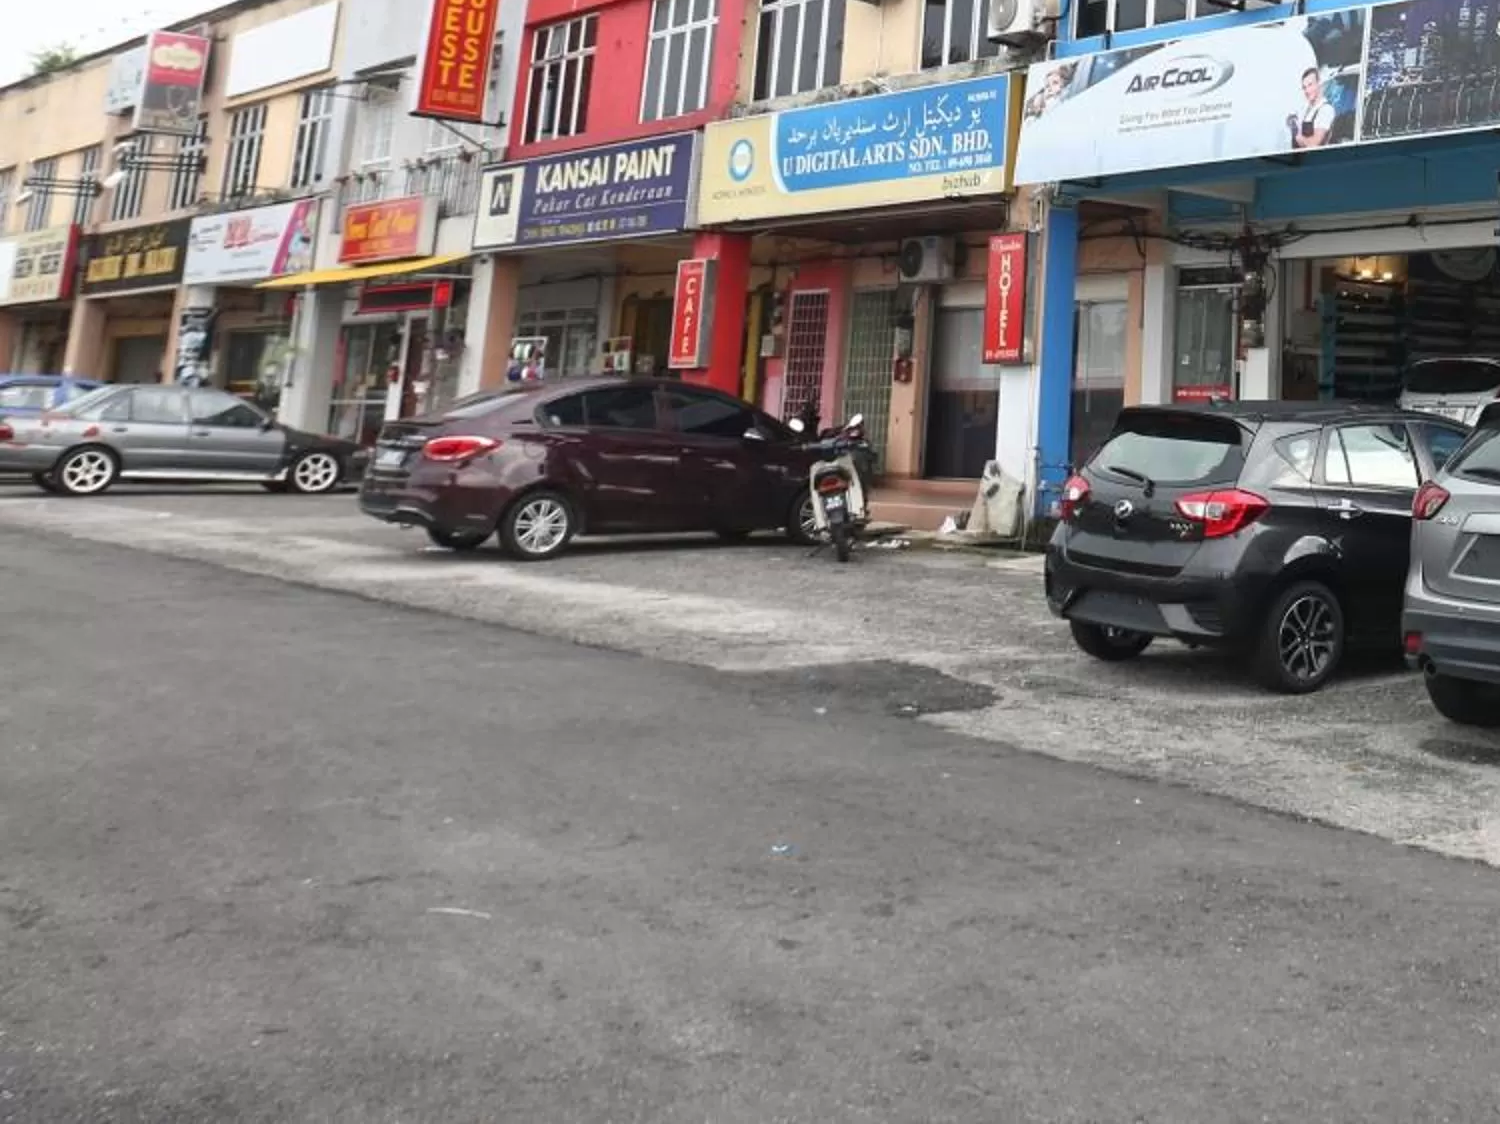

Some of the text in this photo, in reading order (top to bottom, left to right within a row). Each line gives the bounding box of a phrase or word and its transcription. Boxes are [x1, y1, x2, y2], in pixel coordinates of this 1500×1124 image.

[535, 144, 677, 195] KANSAI PAINT
[783, 129, 993, 177] U DIGITAL ARTS SDN. BHD.
[532, 196, 571, 215] Pakar
[600, 185, 673, 207] Kenderaan
[681, 277, 698, 354] CAFE
[999, 252, 1011, 347] HOTEL
